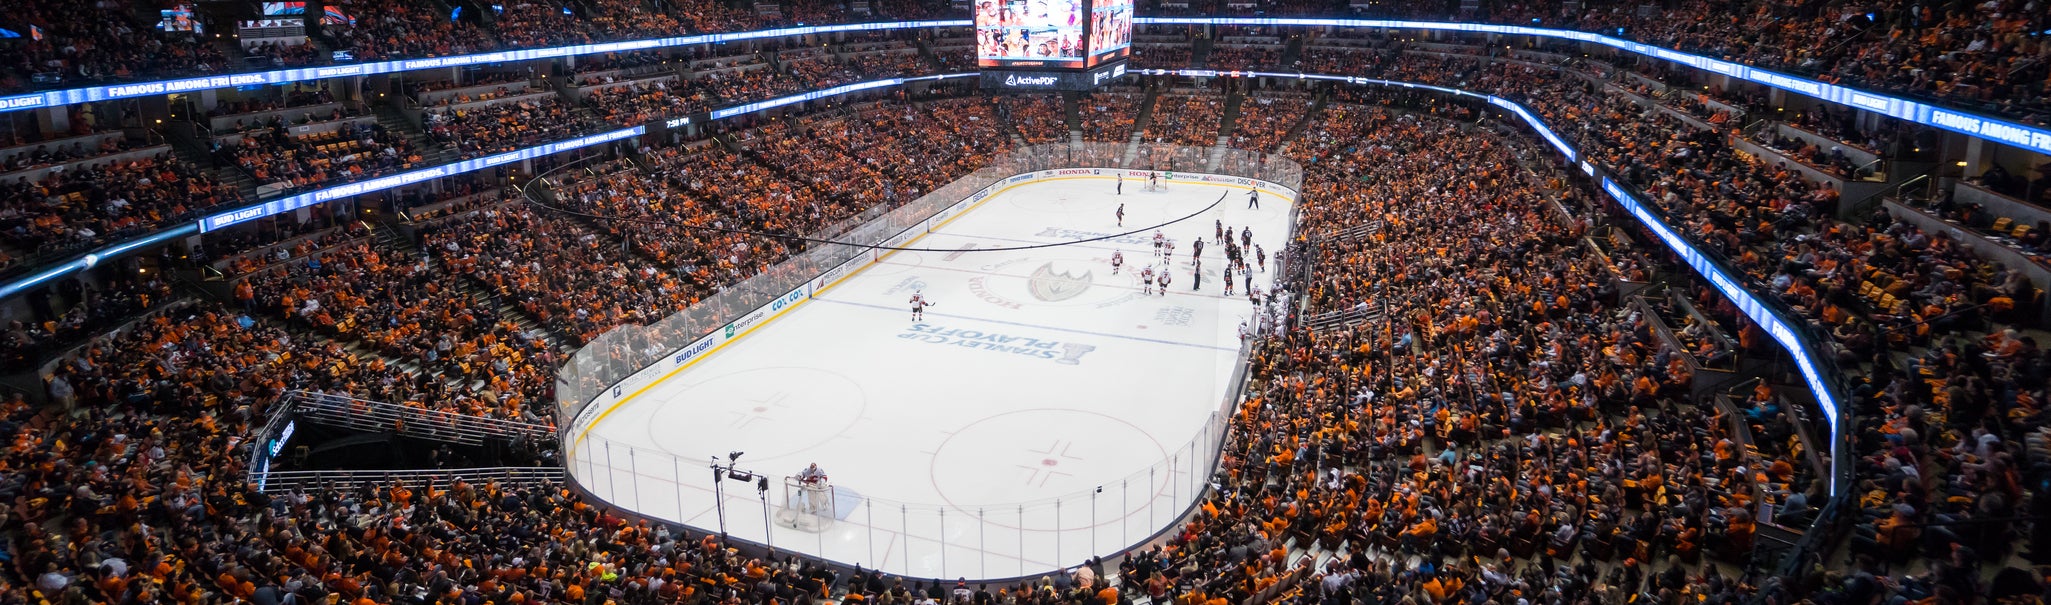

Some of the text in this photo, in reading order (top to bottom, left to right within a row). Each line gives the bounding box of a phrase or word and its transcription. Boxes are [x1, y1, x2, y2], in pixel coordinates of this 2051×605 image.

[109, 84, 164, 97] FAMOUS
[166, 79, 210, 92] AMONG
[9, 96, 43, 108] LIGHT
[1932, 111, 1980, 133] FAMOUS
[1980, 122, 2030, 145] AMONG
[315, 184, 362, 201] FAMOUS
[363, 175, 402, 192] AMONG
[972, 189, 989, 203] GEICO
[214, 207, 263, 226] BUD LIGHT
[897, 333, 1061, 360] STANLEY CUP
[907, 323, 1058, 350] PLAYOFFS
[675, 338, 714, 364] BUD LIGHT
